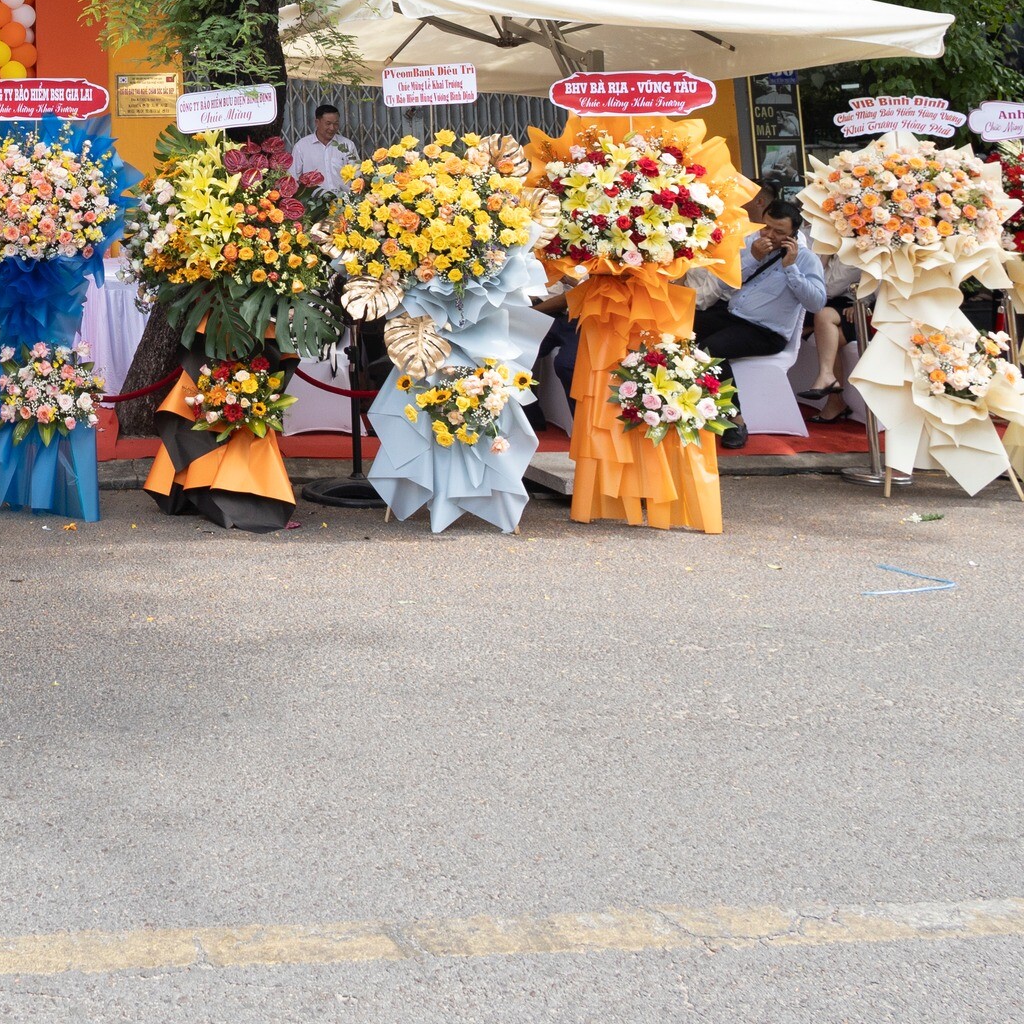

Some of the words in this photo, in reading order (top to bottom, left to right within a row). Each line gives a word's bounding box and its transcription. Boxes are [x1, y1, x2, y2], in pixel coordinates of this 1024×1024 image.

[384, 66, 435, 79] PVcomBank
[4, 88, 13, 102] TY
[14, 84, 29, 102] BẢO
[30, 81, 49, 102] HIỂM
[50, 88, 65, 102] BSH
[66, 88, 80, 102] GIA
[80, 88, 93, 102] LAI
[564, 82, 588, 95] BHV
[590, 79, 606, 94] BÀ
[608, 81, 629, 96] RỊA
[637, 79, 671, 94] VŨNG
[674, 79, 698, 94] TÀU
[579, 96, 601, 107] Chúc
[602, 96, 629, 110] Mừng
[631, 96, 653, 107] Khai
[656, 96, 686, 110] Trương
[852, 99, 875, 110] VIB
[878, 97, 910, 108] Bình
[913, 96, 946, 109] Định
[755, 106, 774, 120] CẠO
[756, 123, 777, 139] MẶT
